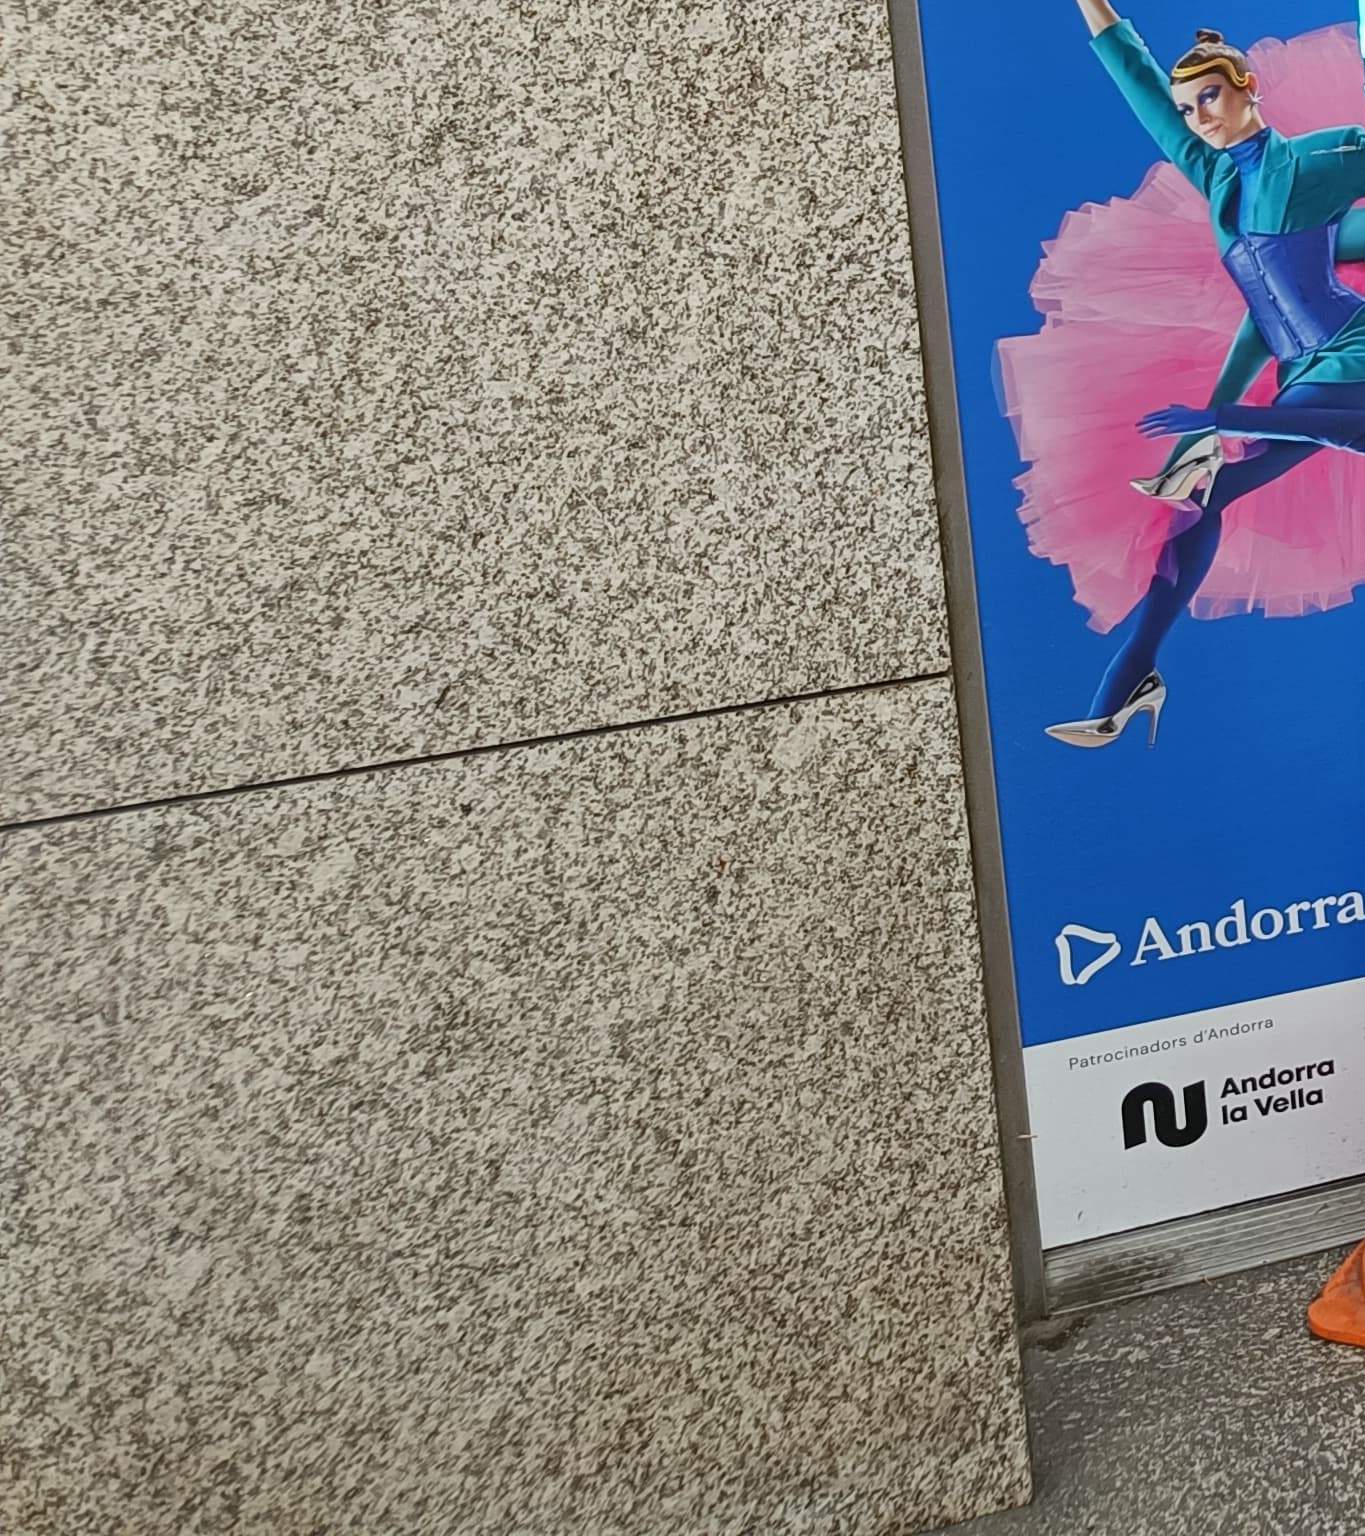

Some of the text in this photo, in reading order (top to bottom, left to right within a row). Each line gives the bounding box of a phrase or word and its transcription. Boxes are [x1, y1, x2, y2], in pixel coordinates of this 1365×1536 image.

[1068, 1017, 1275, 1071] Patrocinadors d'Andorra
[1220, 1060, 1335, 1099] Andorra
[1221, 1088, 1325, 1126] la Vella
